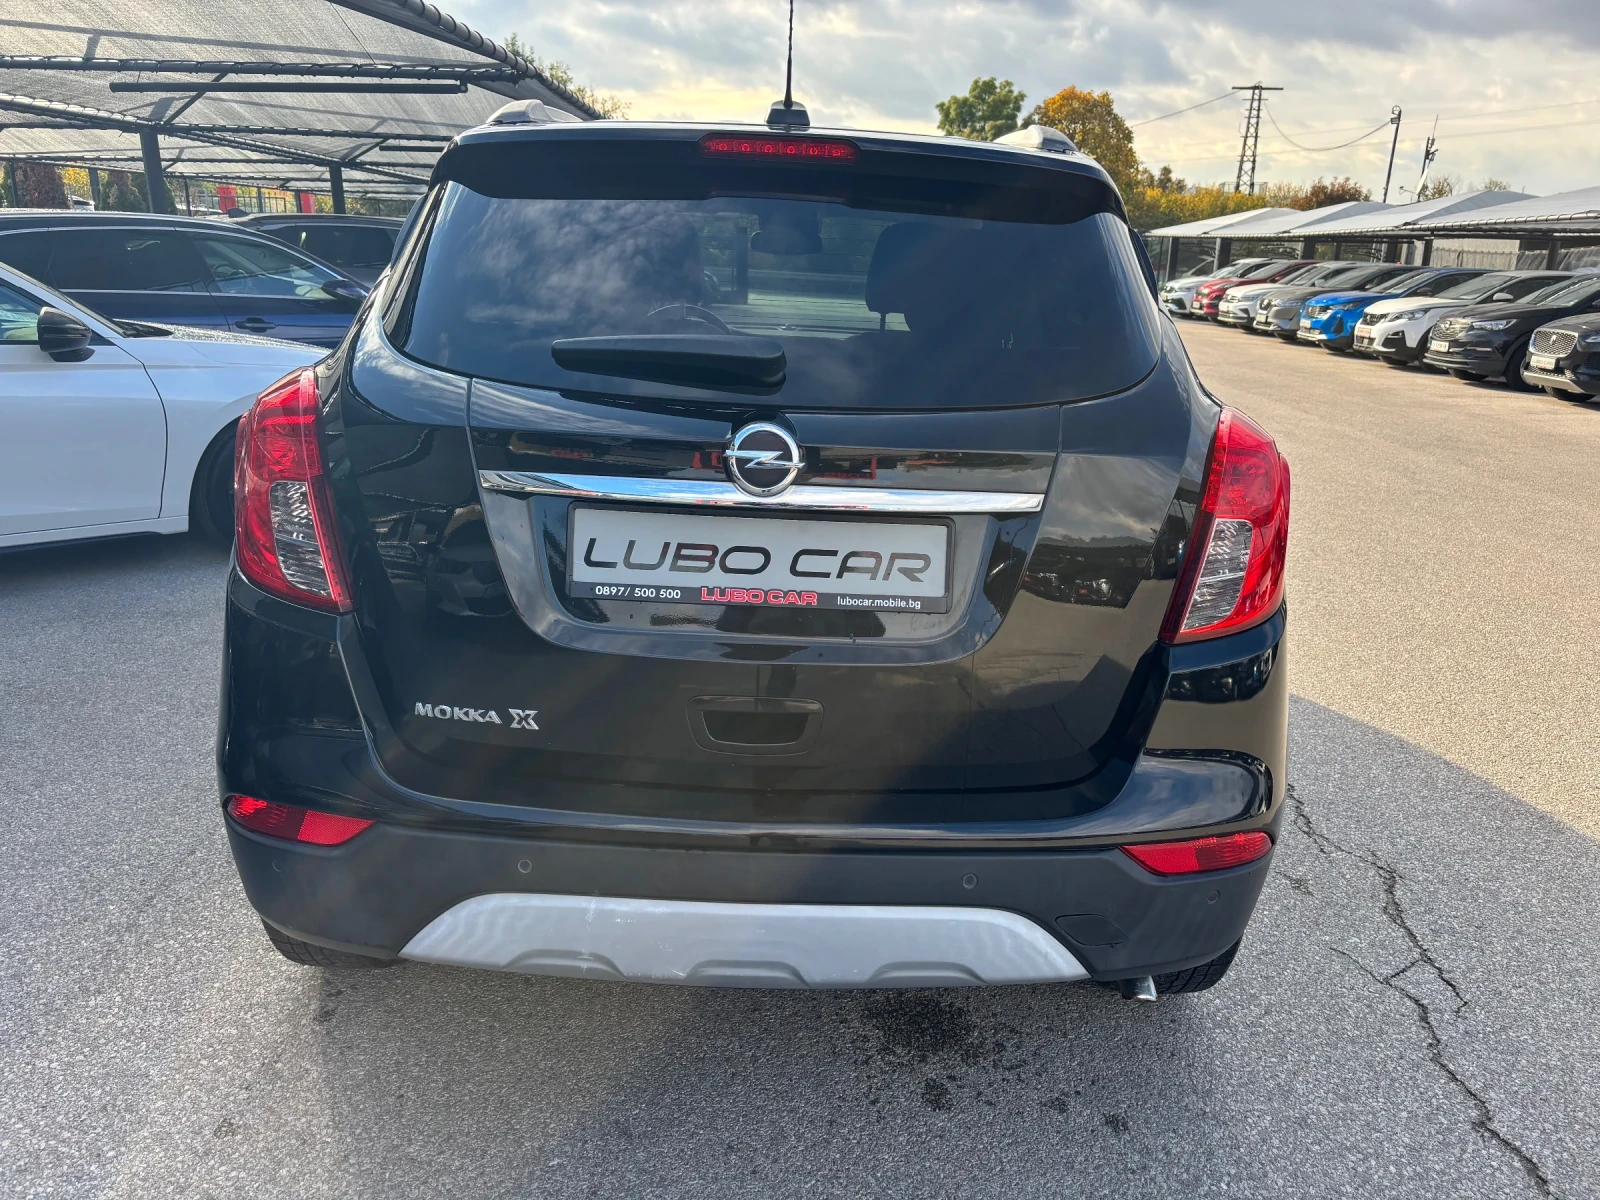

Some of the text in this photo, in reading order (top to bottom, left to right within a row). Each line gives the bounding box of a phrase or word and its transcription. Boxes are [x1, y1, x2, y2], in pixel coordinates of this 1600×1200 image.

[583, 537, 932, 582] LUBO CAR
[595, 585, 681, 599] 0897/ 500 500
[701, 587, 818, 606] LUBO CAR
[837, 596, 921, 610] lubocar.mobile.bg
[414, 702, 540, 730] MOKKA X
